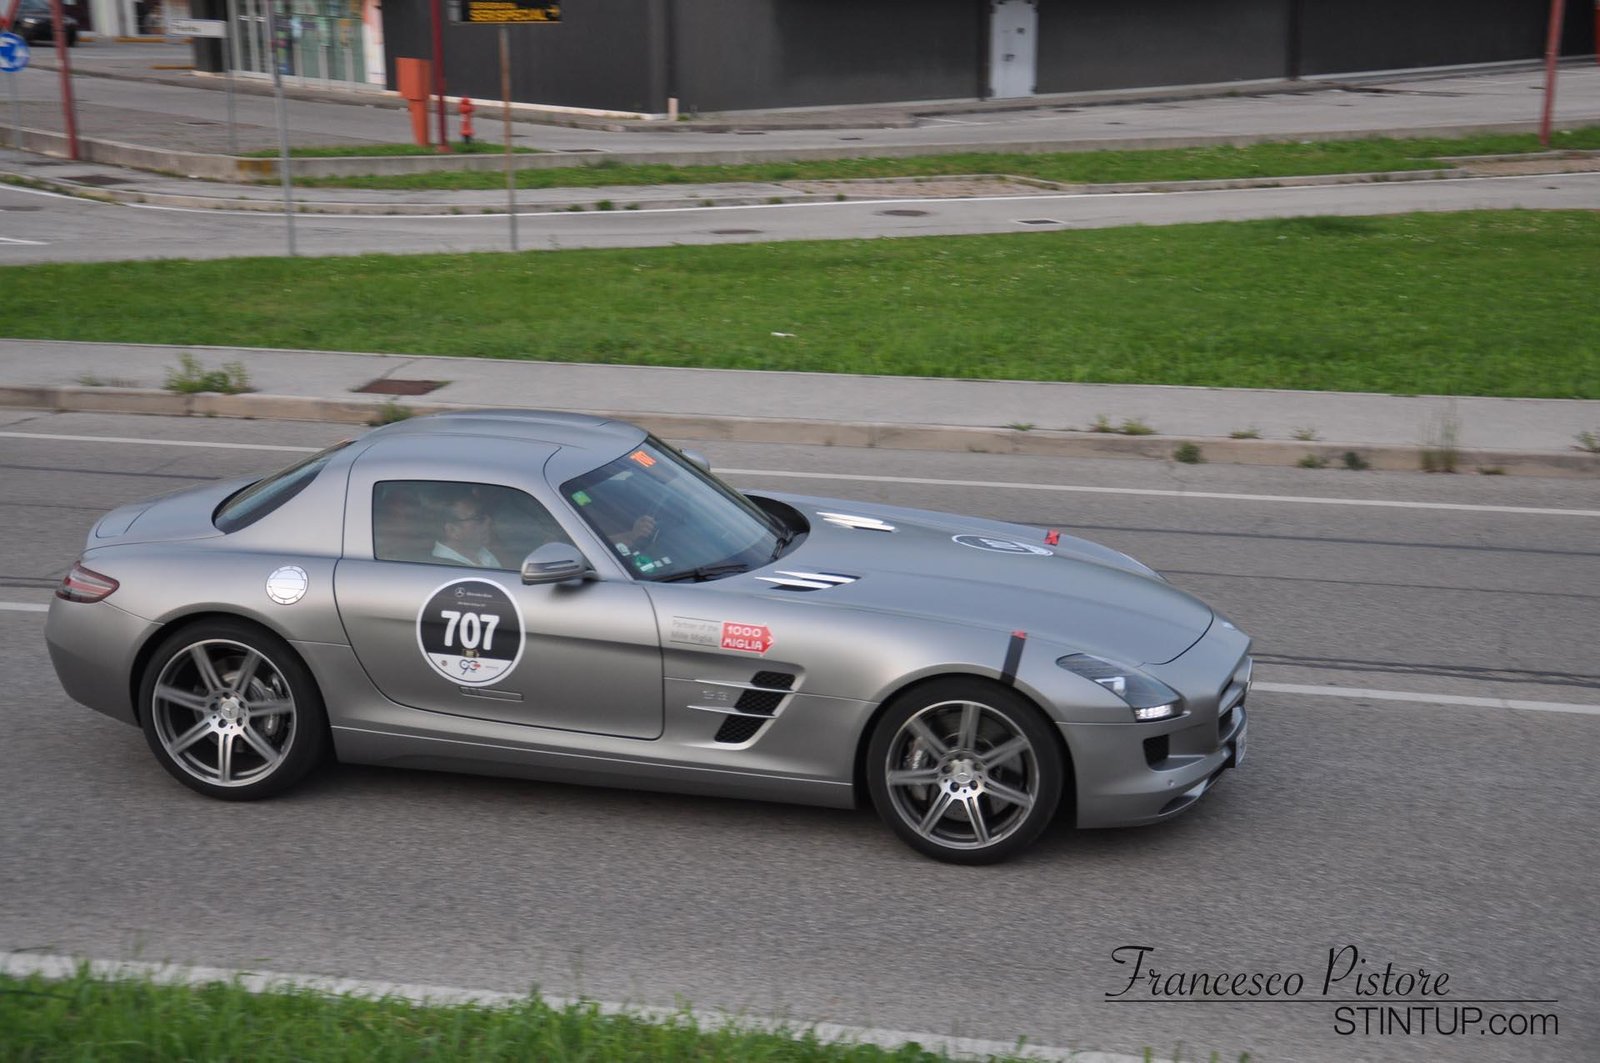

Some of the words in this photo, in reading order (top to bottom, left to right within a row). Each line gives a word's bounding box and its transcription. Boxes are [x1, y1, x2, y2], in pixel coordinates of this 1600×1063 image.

[441, 610, 500, 651] 707
[727, 624, 762, 637] 1000
[723, 637, 763, 651] MIGLIA
